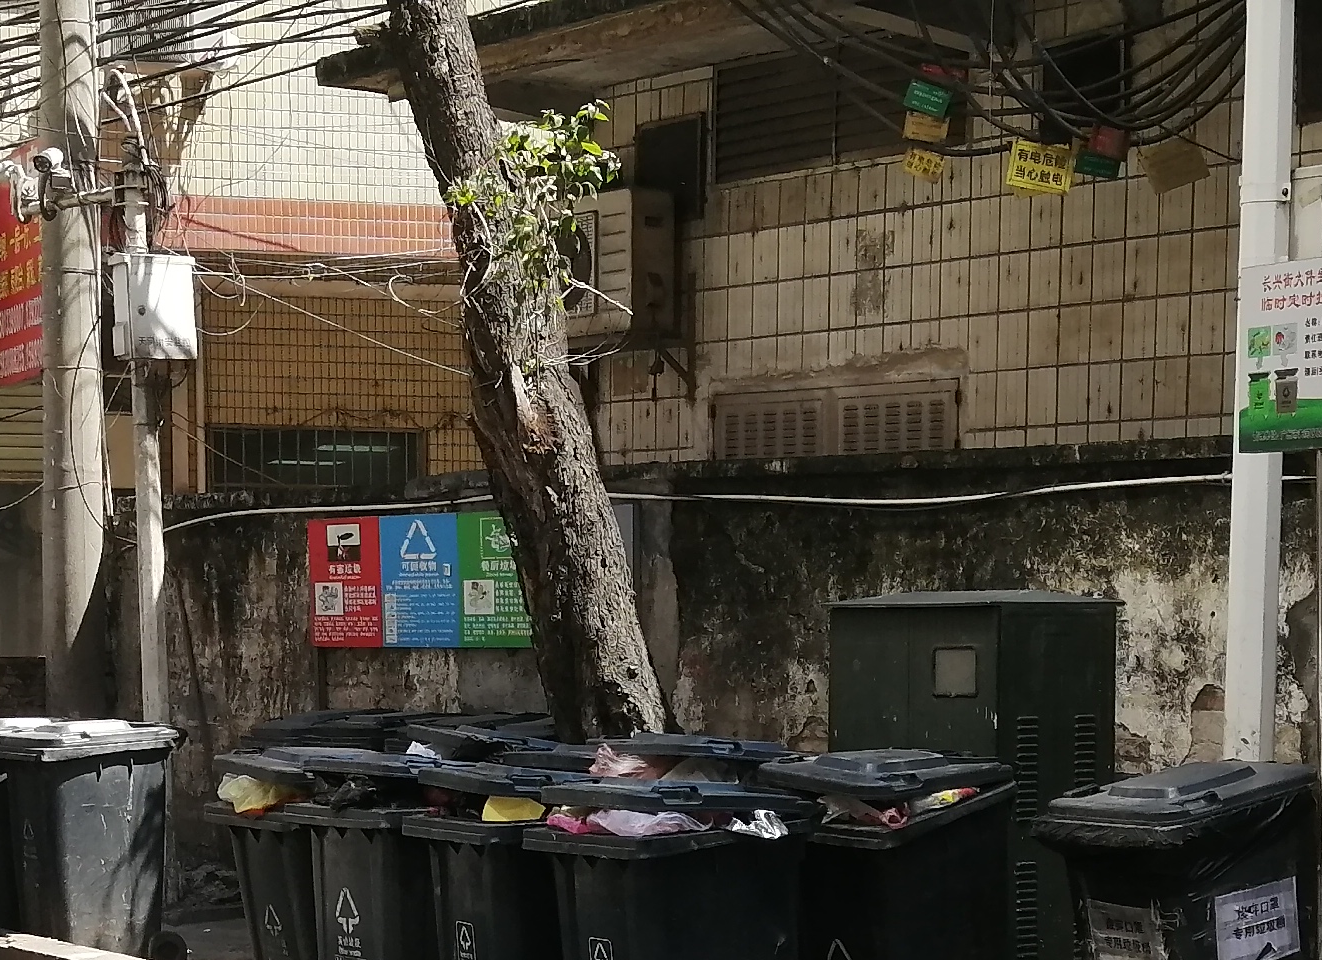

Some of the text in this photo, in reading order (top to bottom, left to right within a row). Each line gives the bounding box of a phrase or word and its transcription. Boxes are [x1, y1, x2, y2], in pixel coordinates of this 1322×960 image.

[1017, 148, 1067, 170] 有电危险
[1015, 165, 1063, 186] 当心触电
